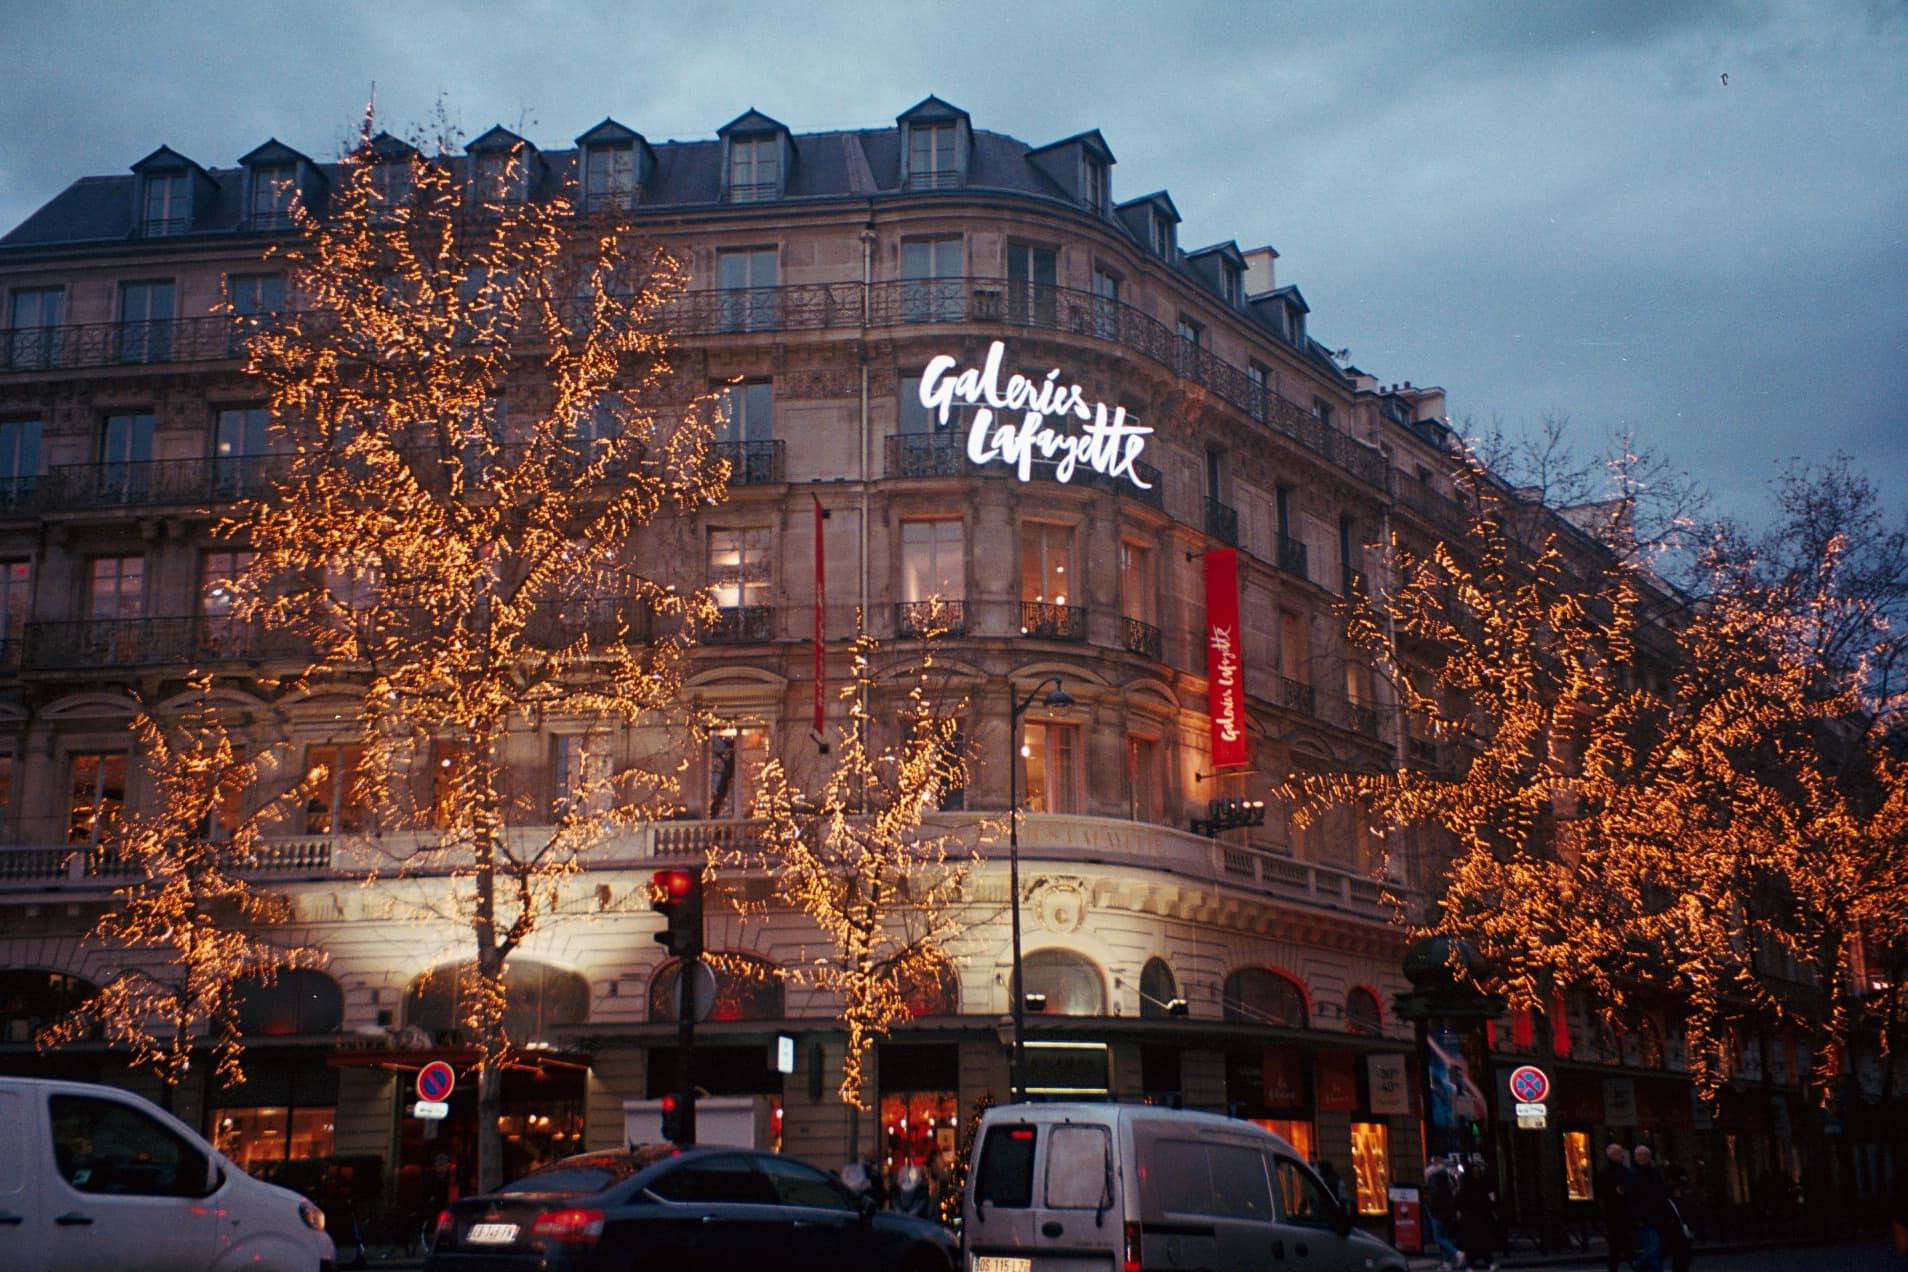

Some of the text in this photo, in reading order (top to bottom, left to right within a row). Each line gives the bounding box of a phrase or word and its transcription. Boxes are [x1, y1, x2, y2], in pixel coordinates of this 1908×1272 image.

[919, 340, 1091, 425] Galeries
[967, 402, 1154, 489] Lafayette
[1210, 624, 1241, 742] Galeries Lafayette
